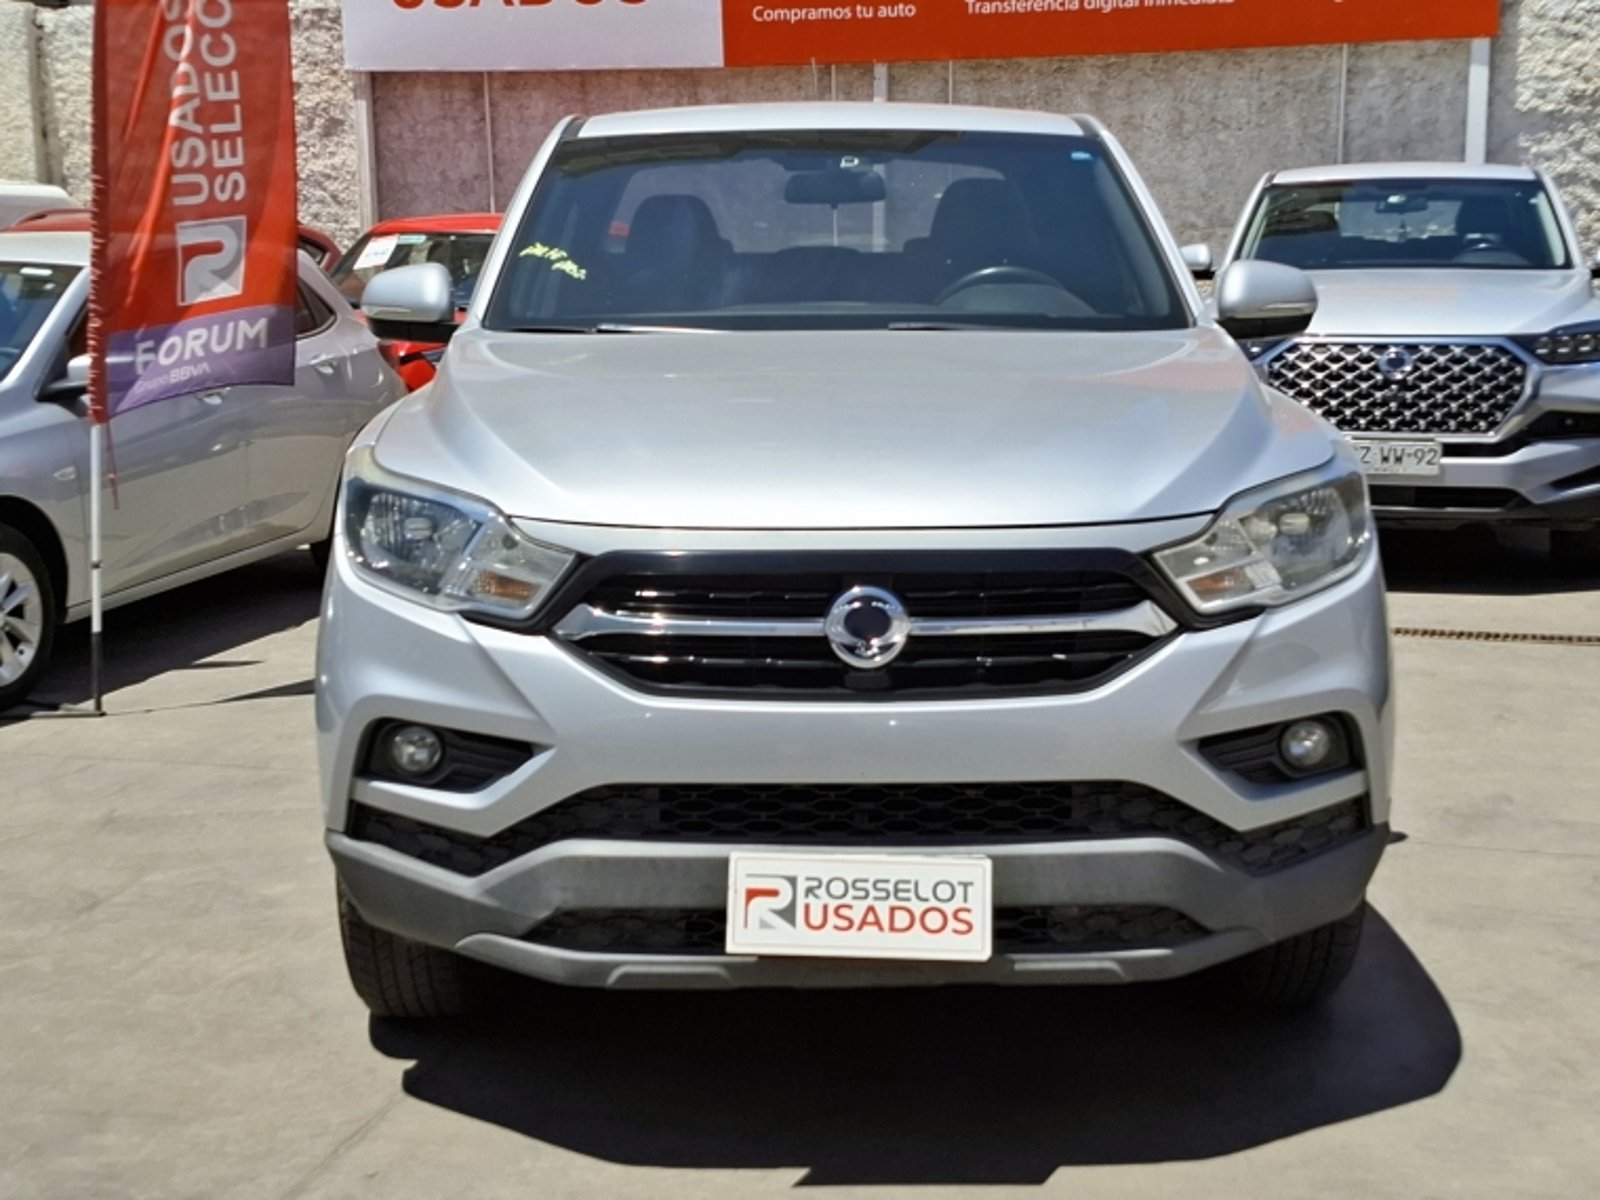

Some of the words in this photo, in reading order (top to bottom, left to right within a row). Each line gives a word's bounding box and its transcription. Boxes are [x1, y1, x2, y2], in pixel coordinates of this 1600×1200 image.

[752, 6, 851, 23] Compramos
[856, 5, 873, 18] tu
[877, 4, 917, 17] auto
[966, 0, 1080, 14] Transferencia
[163, 0, 209, 206] USADOS
[135, 317, 268, 375] FORUM
[169, 362, 211, 383] BBVA
[804, 877, 974, 903] ROSSELOT
[803, 903, 974, 935] USADOS
